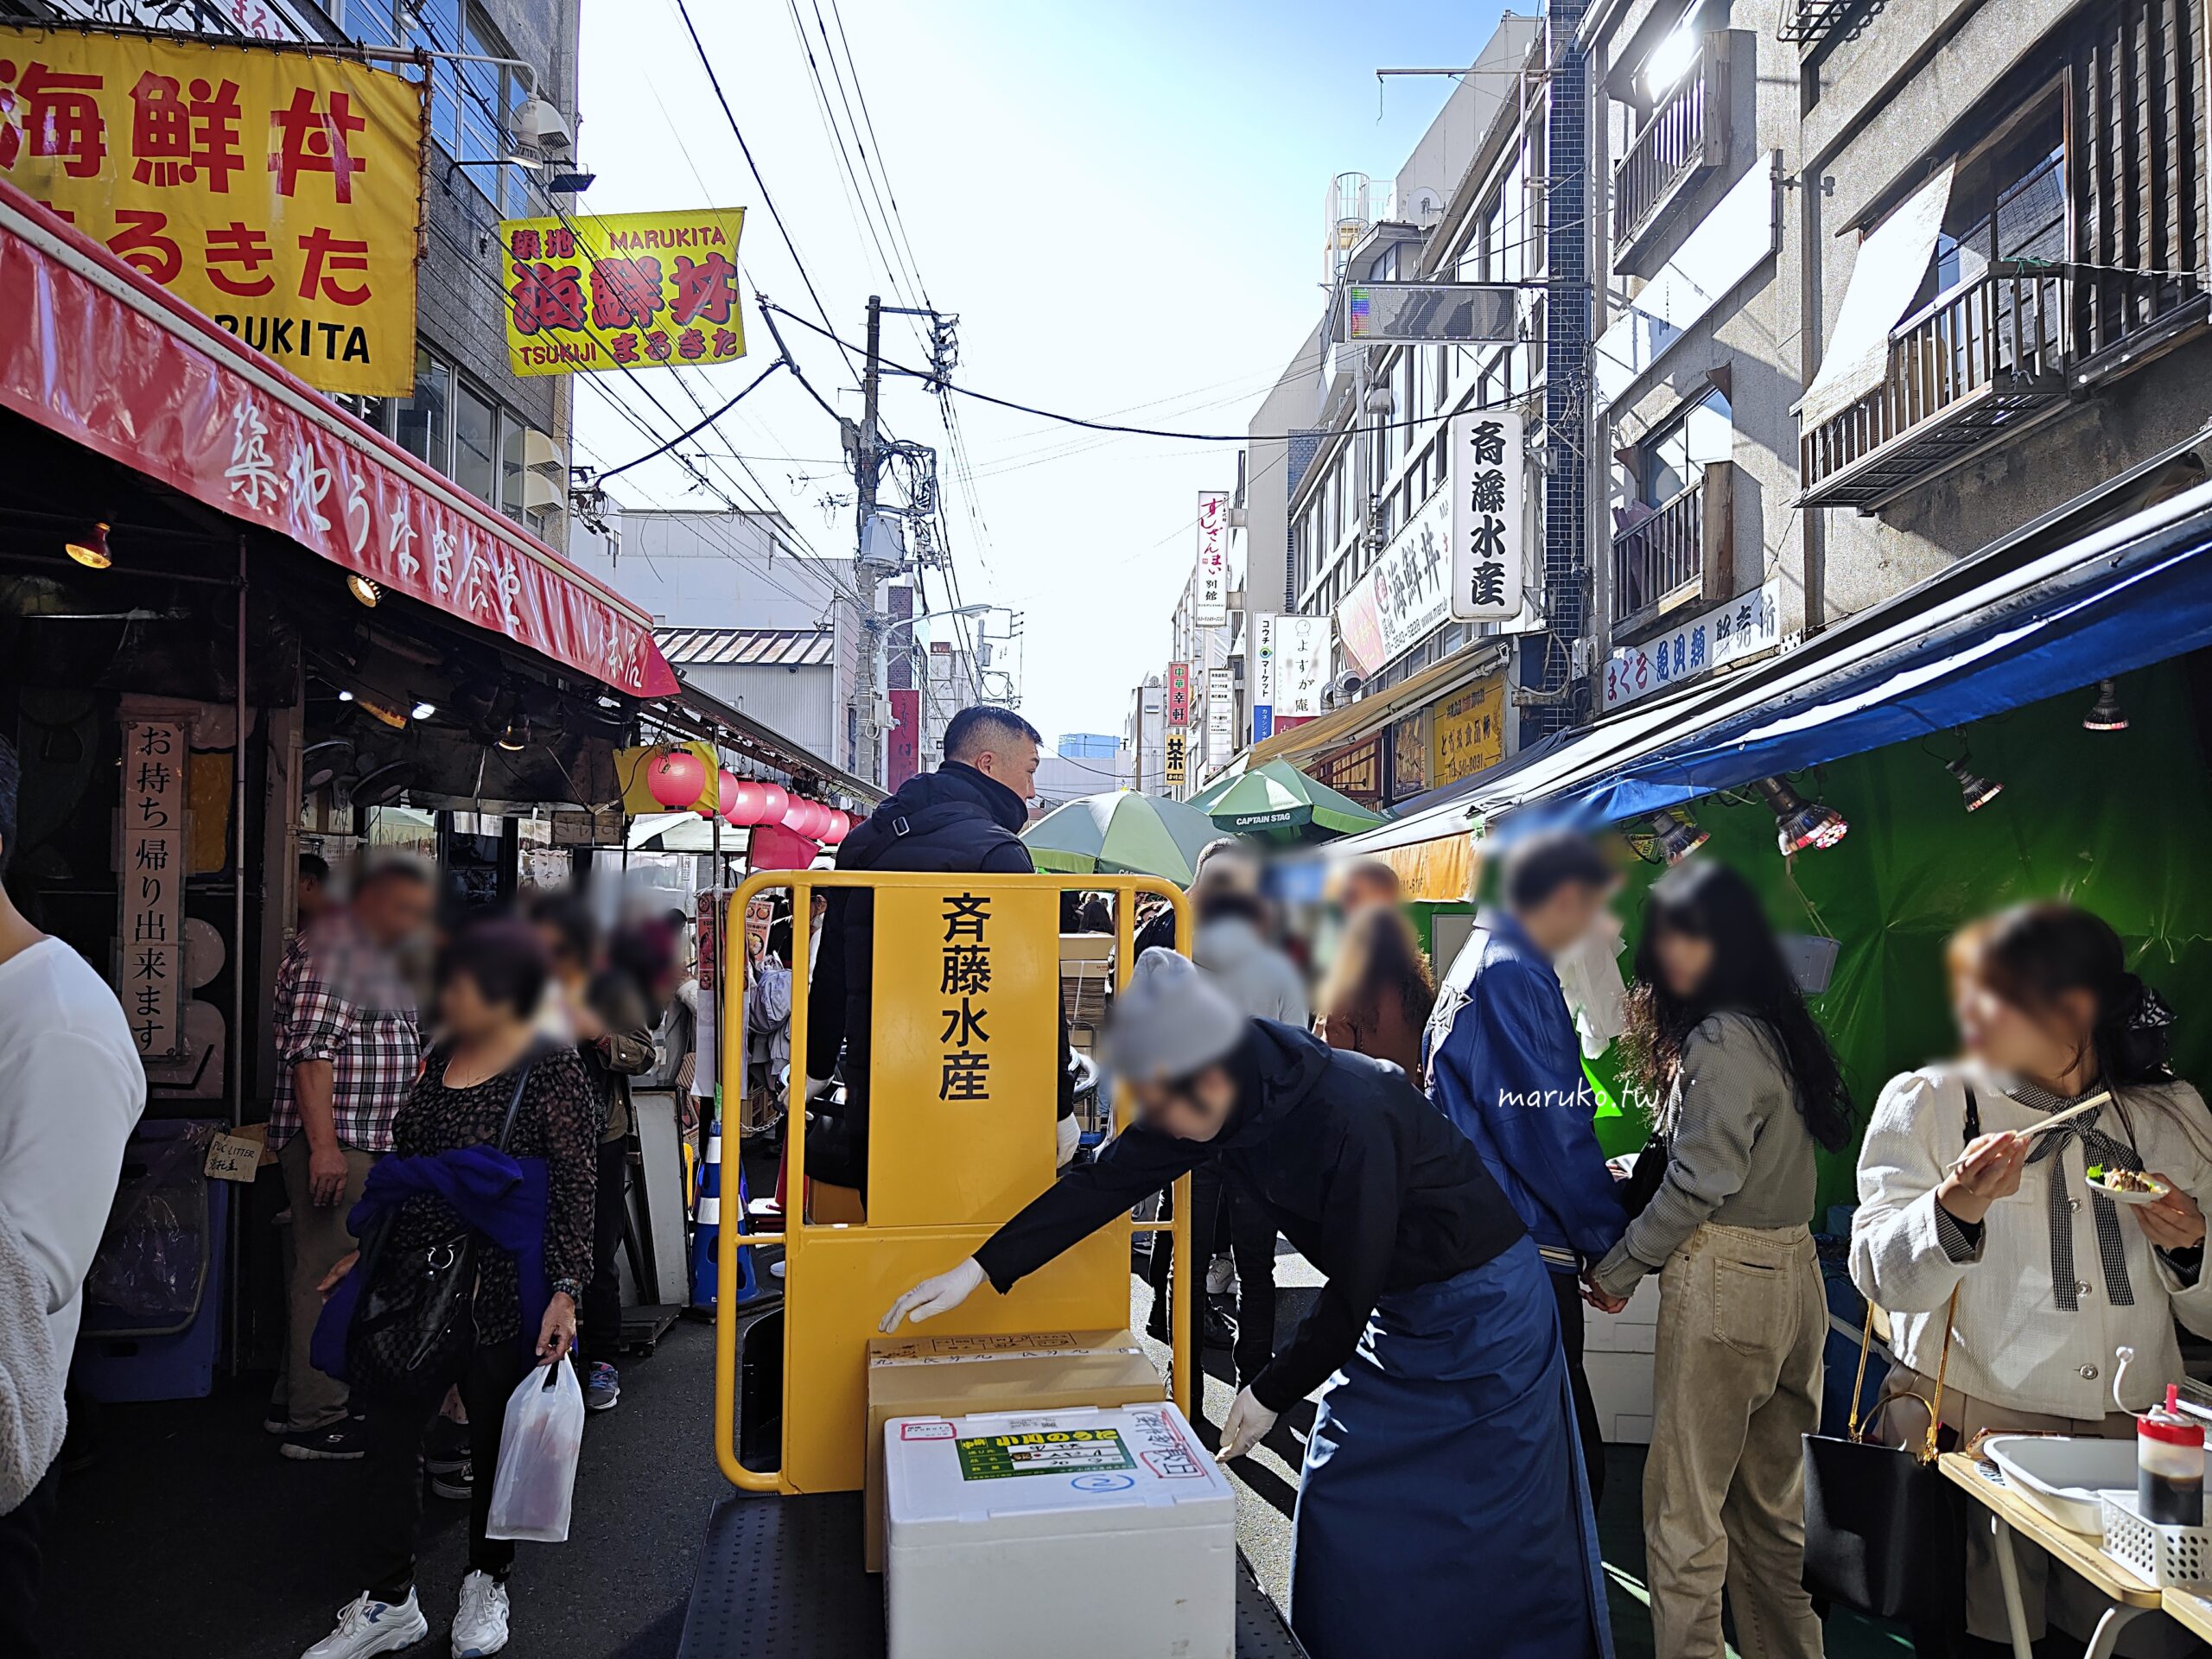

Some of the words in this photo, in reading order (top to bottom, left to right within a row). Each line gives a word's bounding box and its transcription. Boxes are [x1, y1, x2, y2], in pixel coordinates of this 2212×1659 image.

[0, 57, 367, 205] 海鮮丼
[36, 200, 372, 306] るきた
[511, 228, 576, 259] 築地
[609, 226, 726, 251] MARUKITA
[511, 251, 738, 335] 海鮮丼
[519, 342, 597, 366] TSUKIJI
[612, 327, 737, 364] まるきた
[1200, 498, 1224, 575] すしざんまい
[1205, 580, 1218, 601] 別館
[1388, 521, 1441, 622] 海鮮丼
[1295, 639, 1315, 712] よすが庵
[1607, 652, 1648, 701] まぐろ
[1166, 738, 1184, 770] 茶
[1236, 816, 1269, 825] CAPTAIN
[1271, 813, 1291, 823] STAG
[131, 726, 171, 1052] お持ち帰り出来ます
[939, 892, 992, 1102] 斉藤水産
